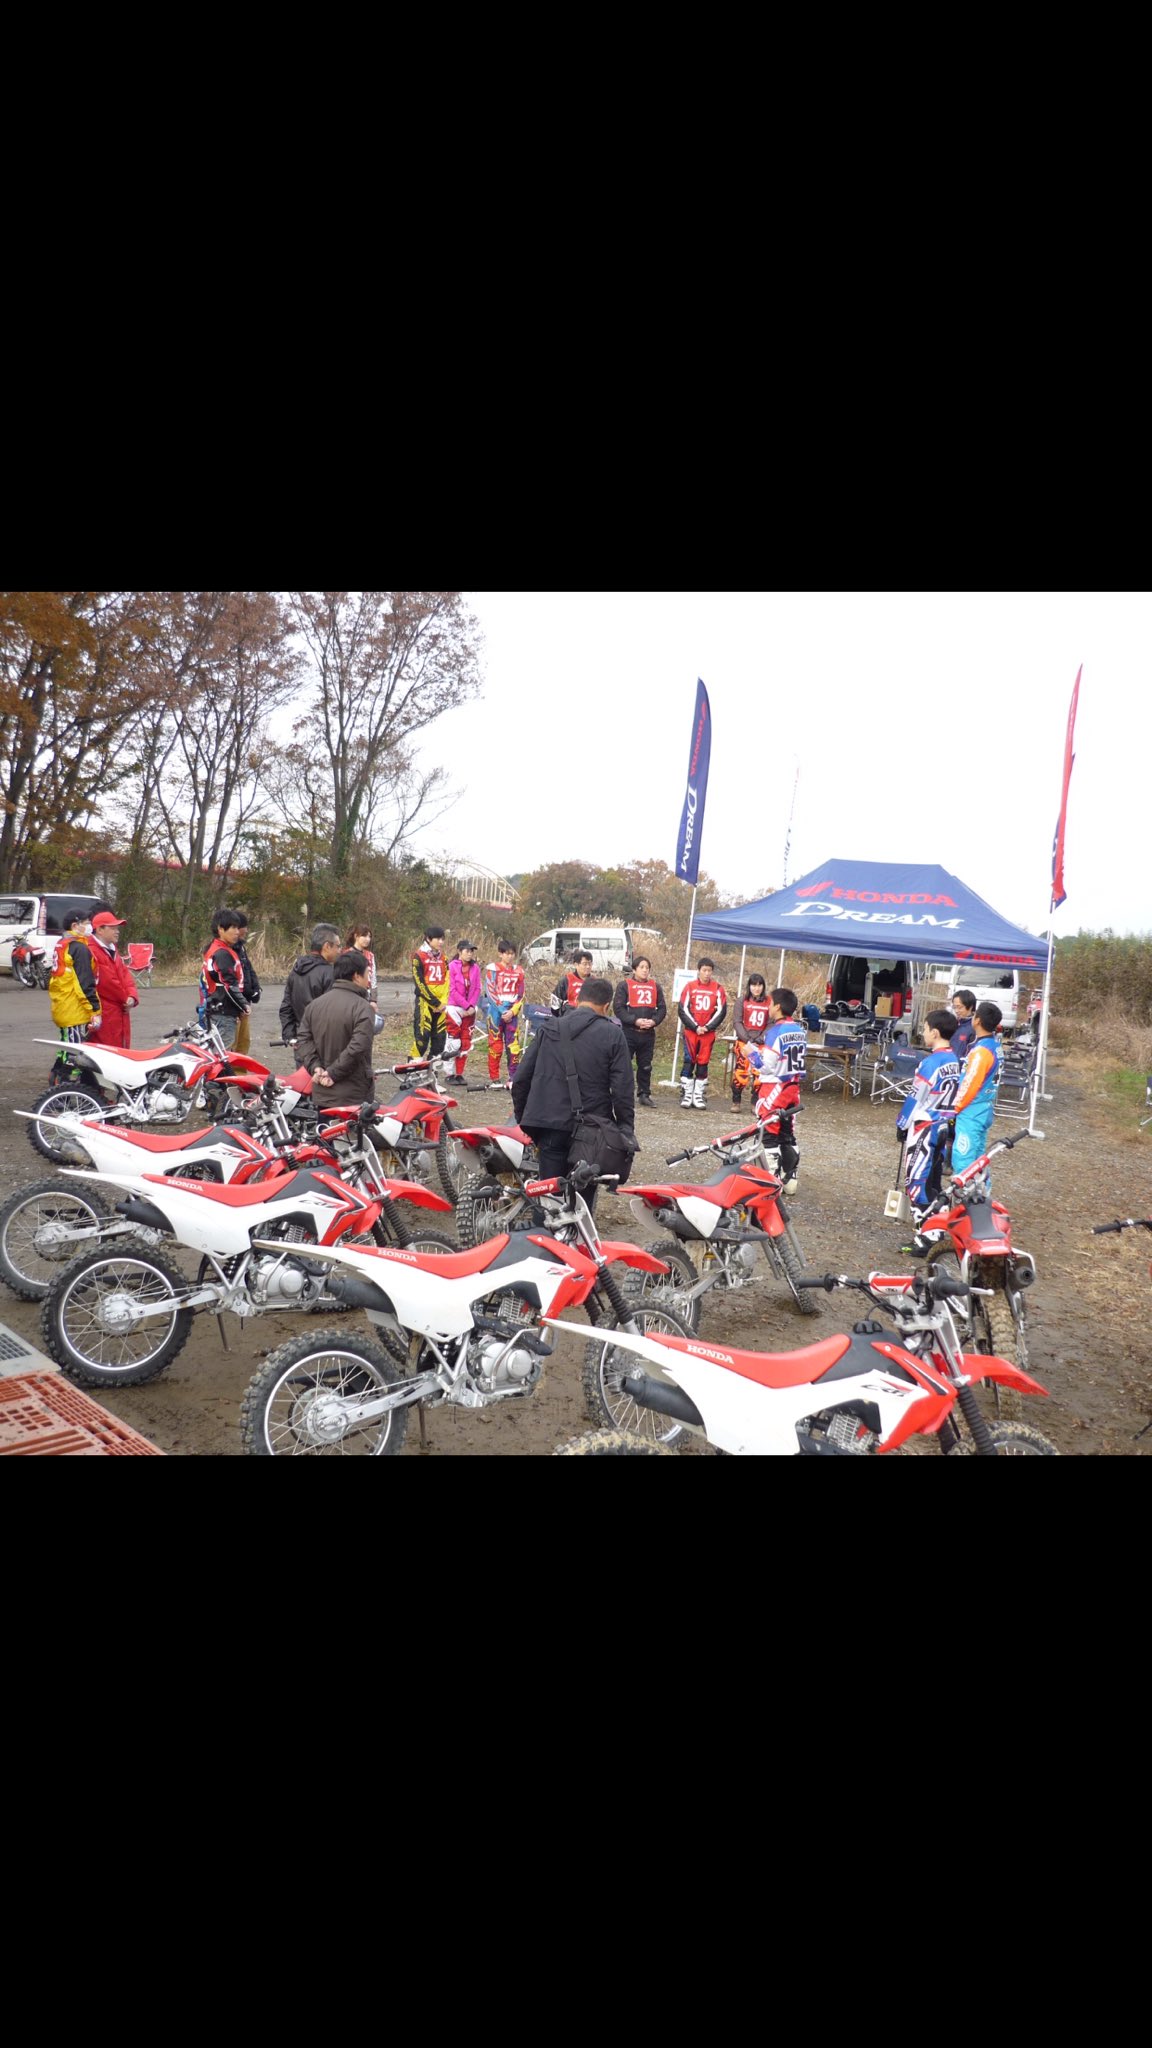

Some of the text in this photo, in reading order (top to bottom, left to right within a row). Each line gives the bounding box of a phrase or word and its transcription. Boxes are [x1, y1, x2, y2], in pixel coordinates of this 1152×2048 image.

[681, 783, 698, 872] DREAM
[831, 887, 959, 908] HONDA
[781, 901, 965, 929] DREAM
[973, 953, 1038, 966] HONDA
[428, 965, 443, 982] 24
[503, 977, 519, 993] 27
[636, 989, 652, 1005] 23
[695, 995, 711, 1011] 50
[748, 1010, 765, 1027] 49
[783, 1045, 806, 1072] 193
[98, 1123, 129, 1138] HONDA
[167, 1178, 204, 1192] HONDA
[377, 1249, 418, 1263] HONDA
[686, 1343, 735, 1365] HONDA
